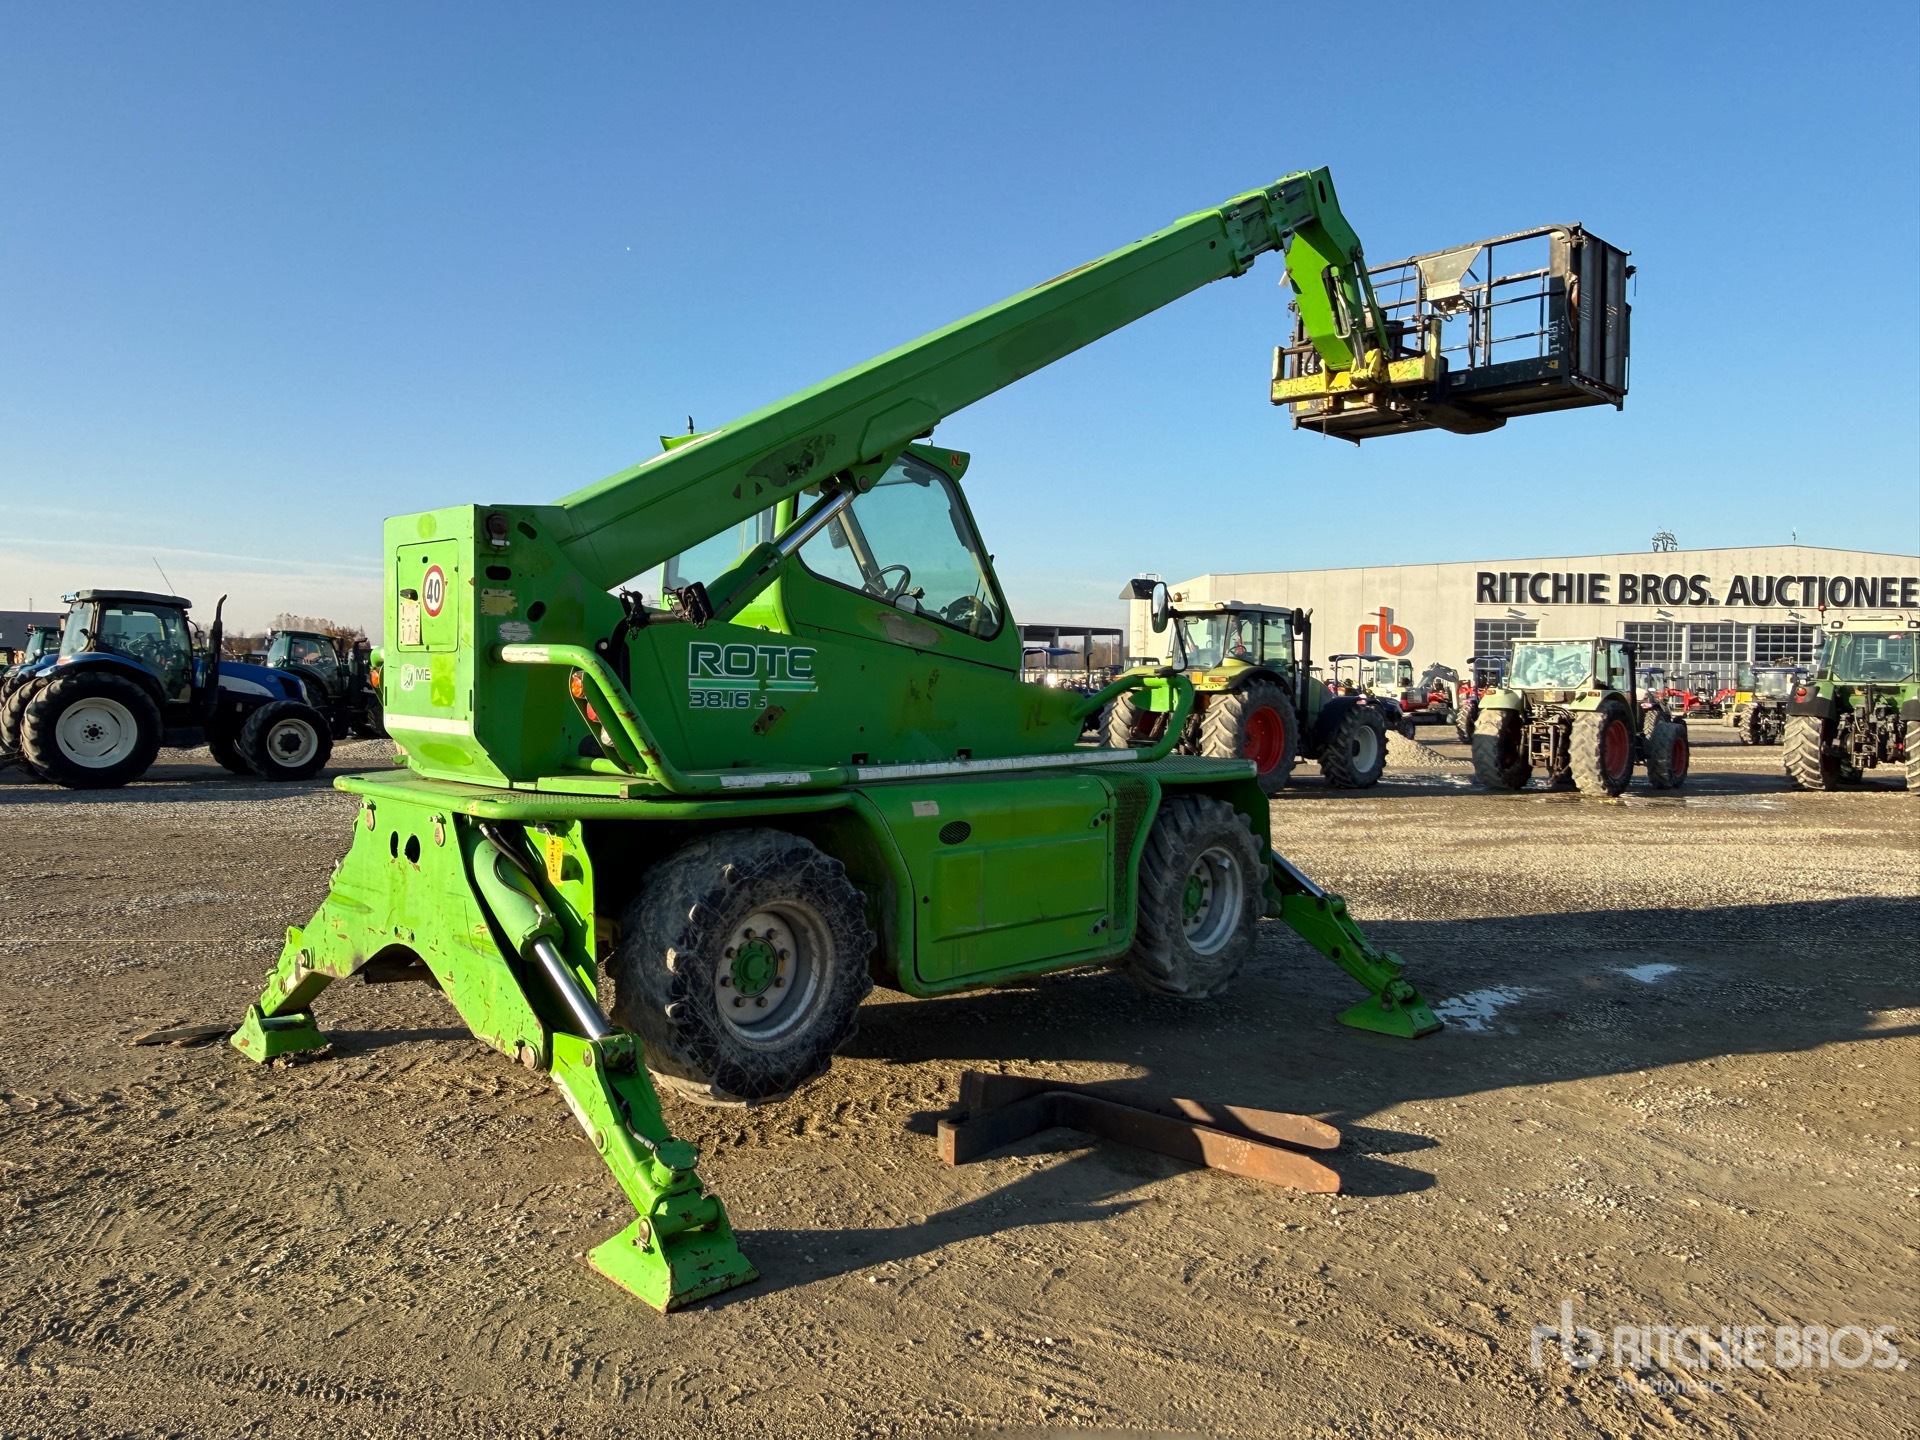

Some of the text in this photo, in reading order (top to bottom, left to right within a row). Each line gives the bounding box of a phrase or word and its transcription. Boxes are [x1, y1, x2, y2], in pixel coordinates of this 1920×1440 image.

[427, 578, 440, 603] 40
[1476, 571, 1611, 604] RITCHIE
[1618, 573, 1718, 605] BROS.
[1358, 606, 1412, 656] rb
[689, 690, 751, 709] 38.16
